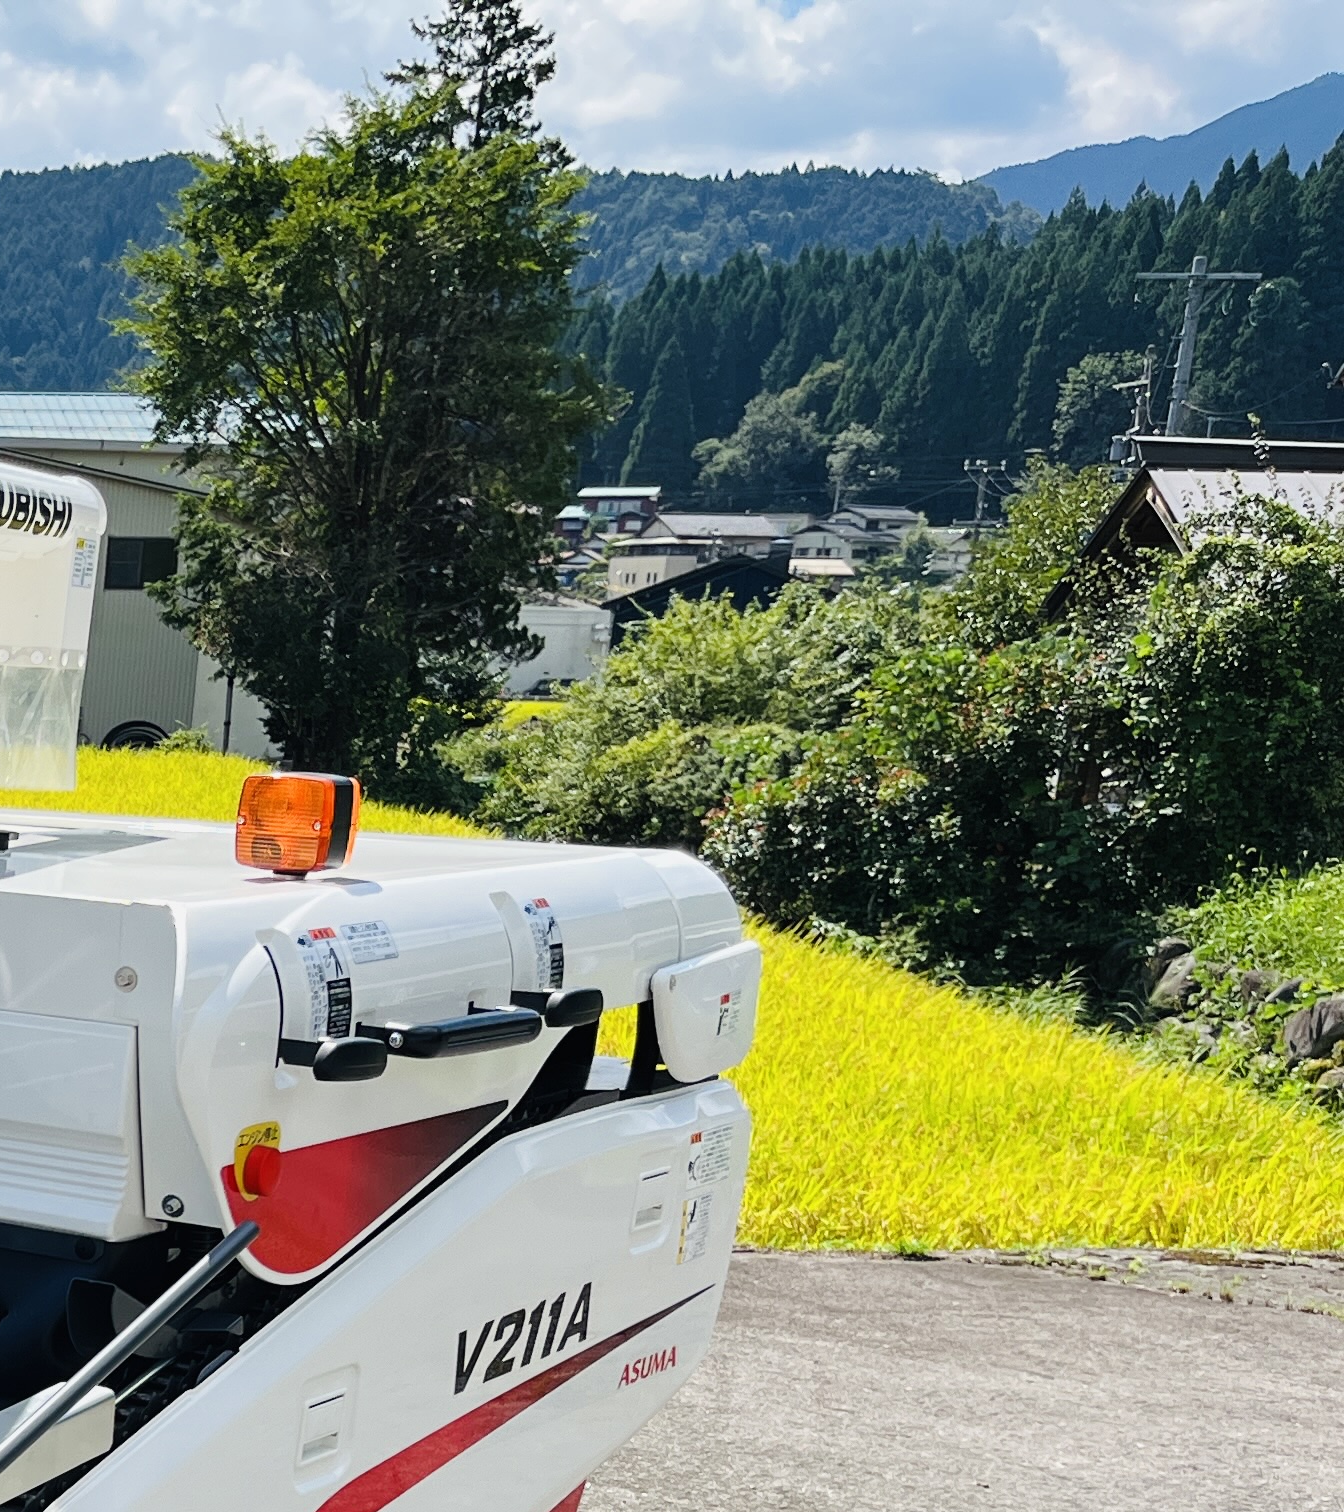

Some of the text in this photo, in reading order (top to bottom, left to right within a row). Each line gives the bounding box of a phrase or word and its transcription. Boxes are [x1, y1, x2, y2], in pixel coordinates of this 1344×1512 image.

[237, 1126, 279, 1148] エンジン停止
[453, 1281, 593, 1395] V211A
[617, 1345, 678, 1390] ASUMA
